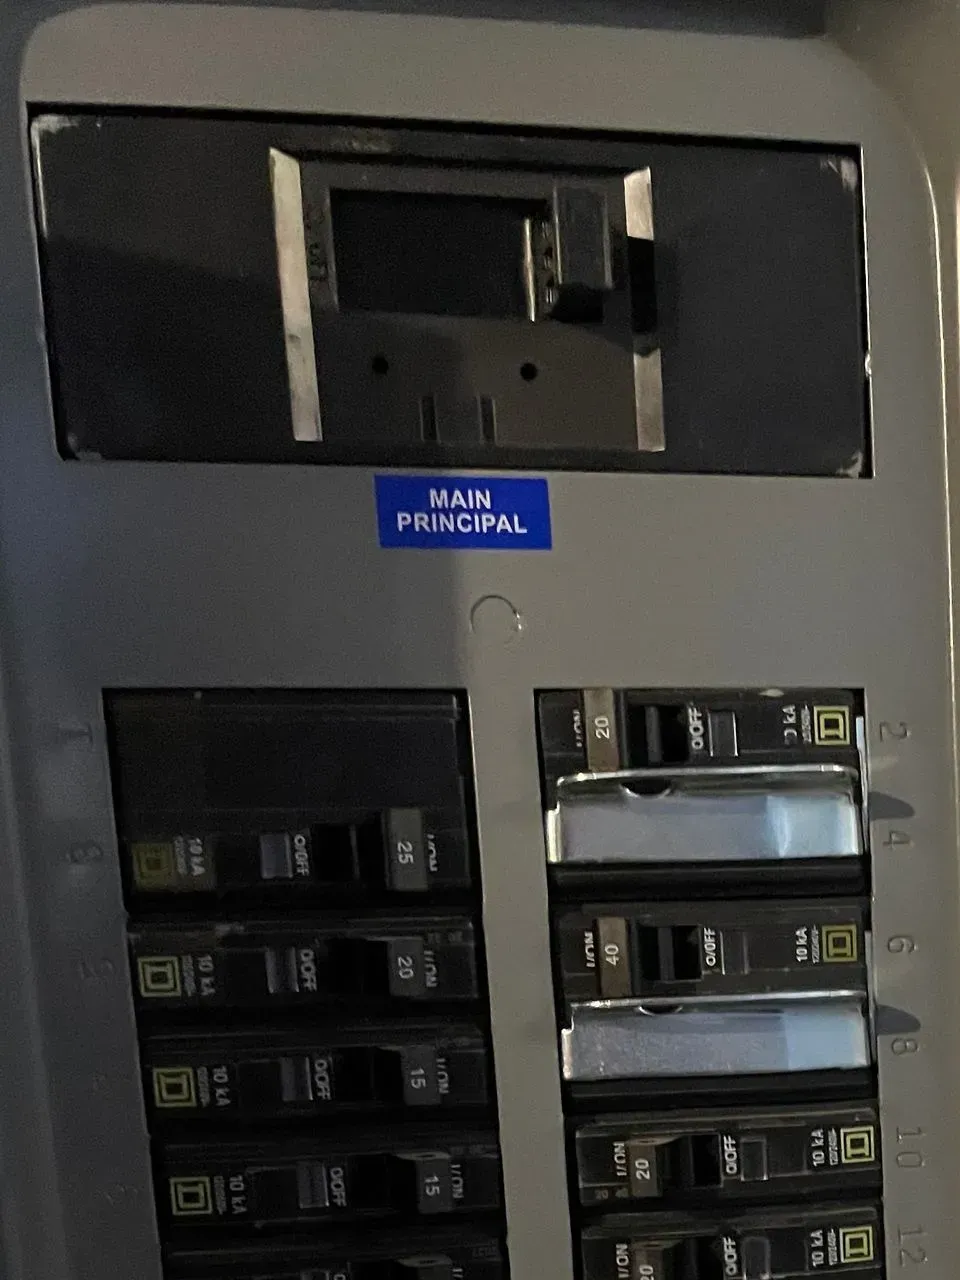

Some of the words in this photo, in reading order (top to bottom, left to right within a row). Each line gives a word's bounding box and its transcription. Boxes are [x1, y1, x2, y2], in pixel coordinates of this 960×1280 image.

[430, 488, 491, 509] MAIN
[397, 512, 527, 533] PRINCIPAL
[595, 714, 610, 741] 20
[396, 840, 413, 866] 25
[605, 942, 619, 967] 40
[397, 954, 414, 980] 20
[411, 1066, 426, 1090] 15
[636, 1157, 651, 1181] 20
[425, 1175, 440, 1198] 15
